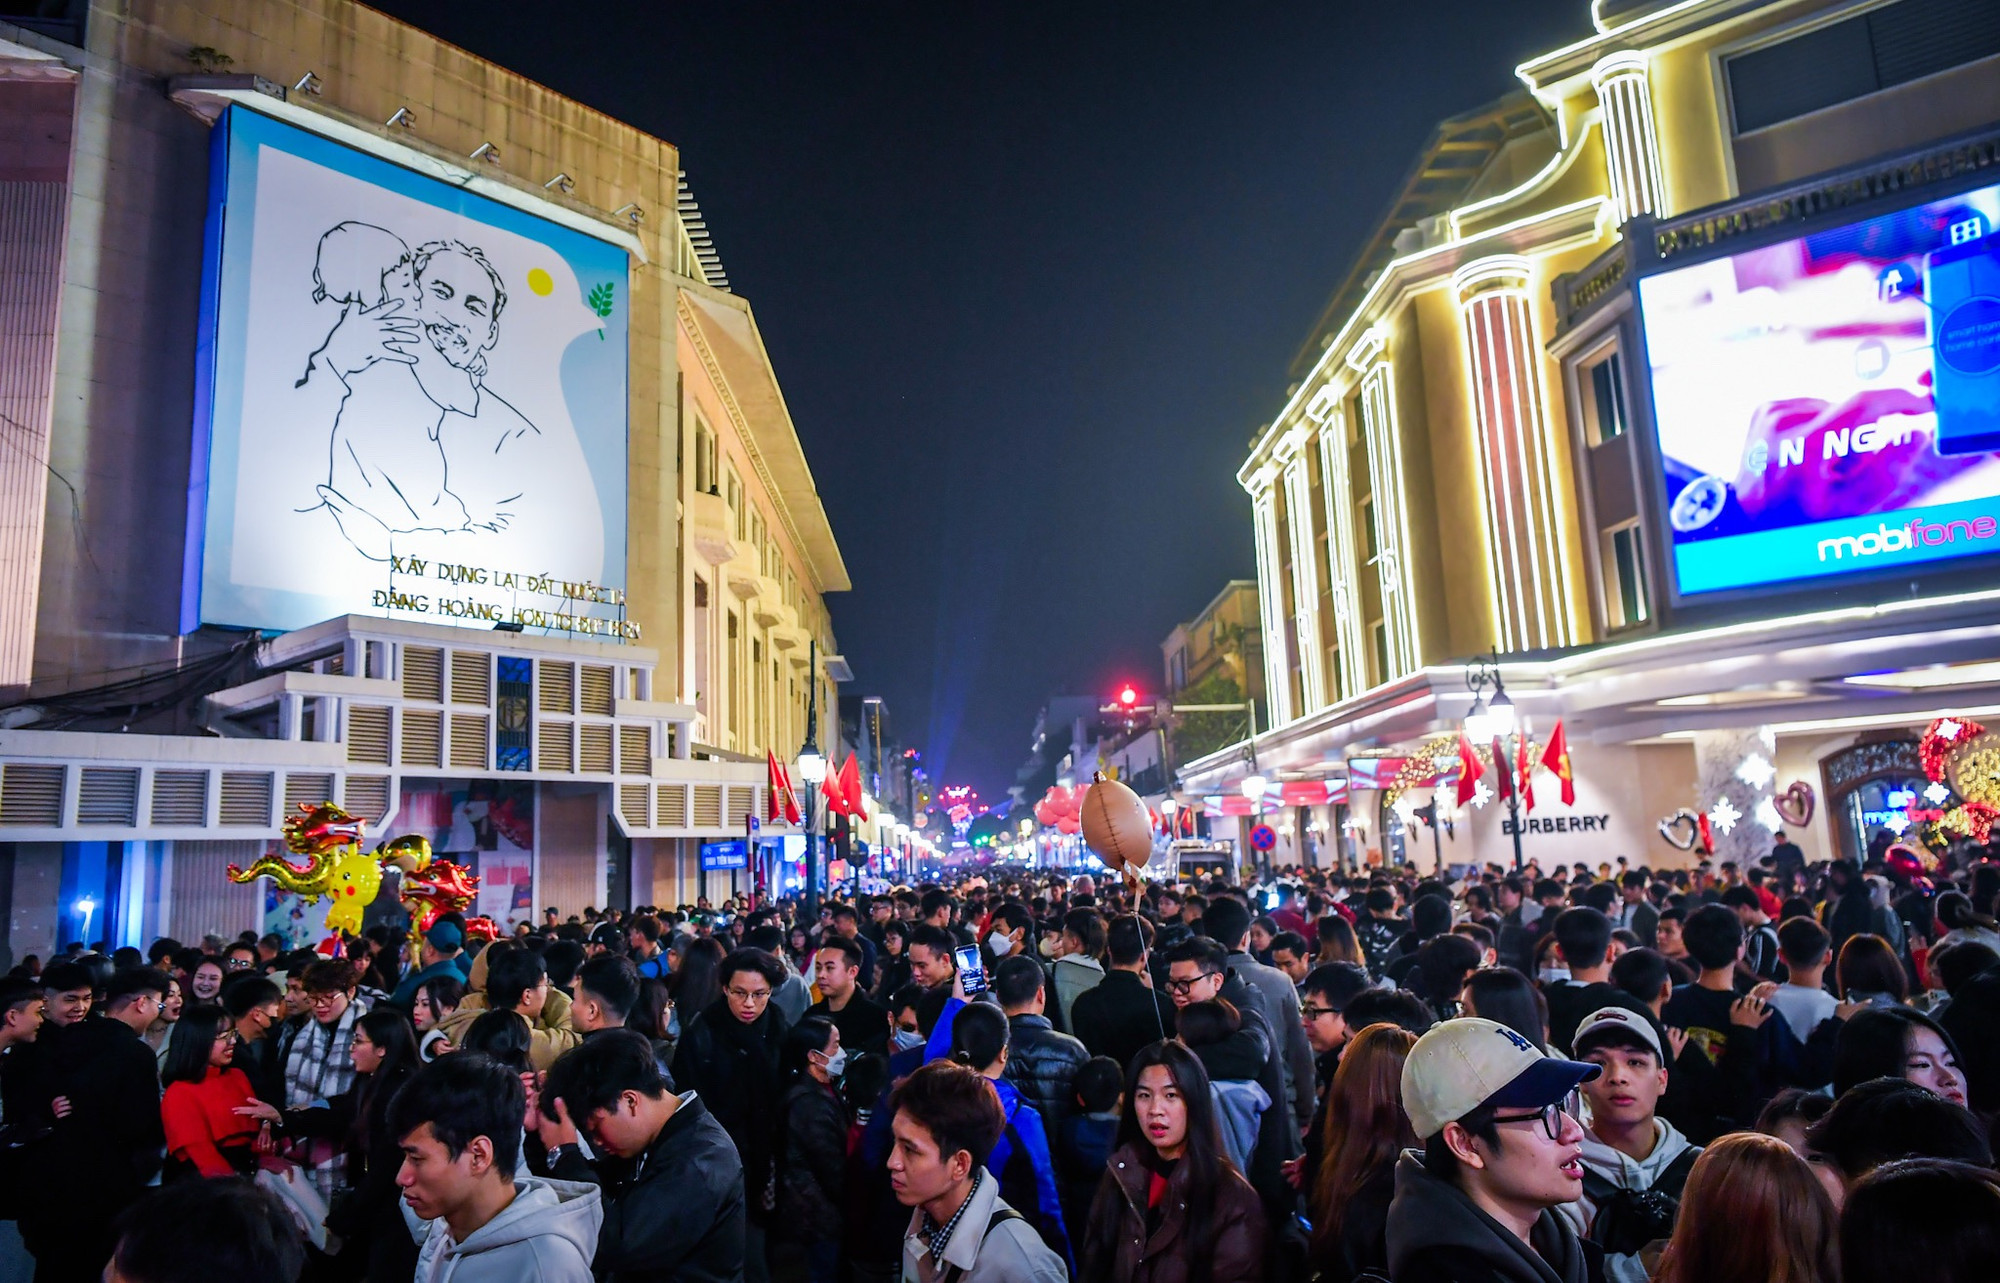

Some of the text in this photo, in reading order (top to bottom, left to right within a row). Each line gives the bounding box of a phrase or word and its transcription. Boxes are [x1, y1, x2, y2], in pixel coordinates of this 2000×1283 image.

[1817, 516, 1997, 562] mobifone
[391, 553, 428, 576] XÂY
[438, 562, 488, 585] DỰNG
[438, 596, 503, 621] HOÀNG
[1501, 814, 1609, 835] BURBERRY
[1495, 1028, 1532, 1052] LA
